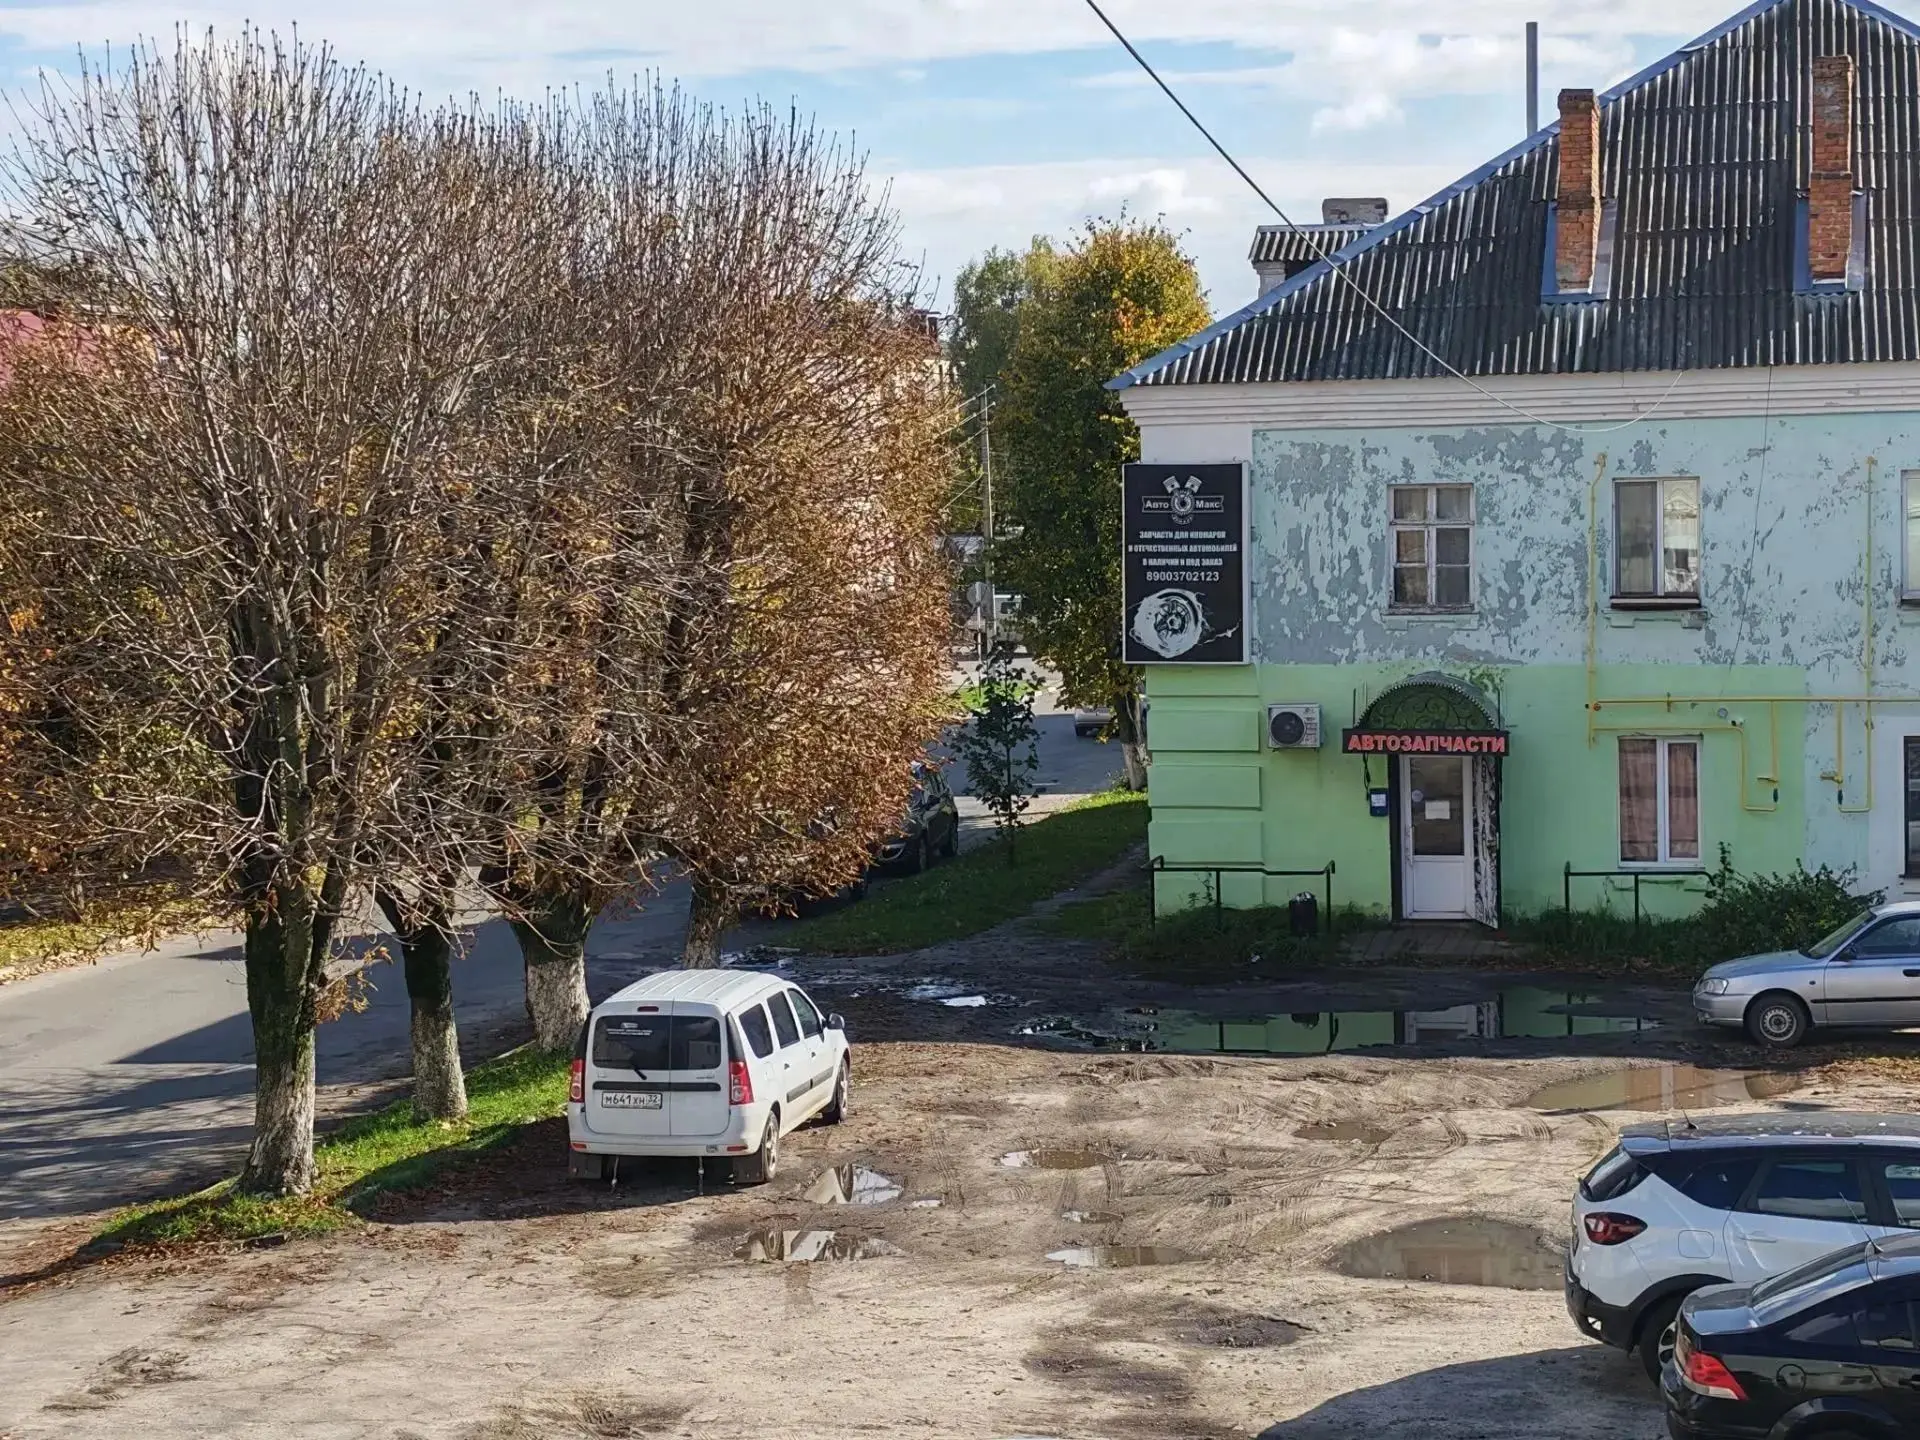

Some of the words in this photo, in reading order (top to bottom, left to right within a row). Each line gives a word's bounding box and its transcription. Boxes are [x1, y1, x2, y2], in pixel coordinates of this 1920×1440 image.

[1145, 500, 1170, 509] Авто
[1195, 500, 1220, 509] Макс
[1146, 571, 1220, 582] 89003702123
[1347, 734, 1505, 753] АВТОЗАПЧАСТИ
